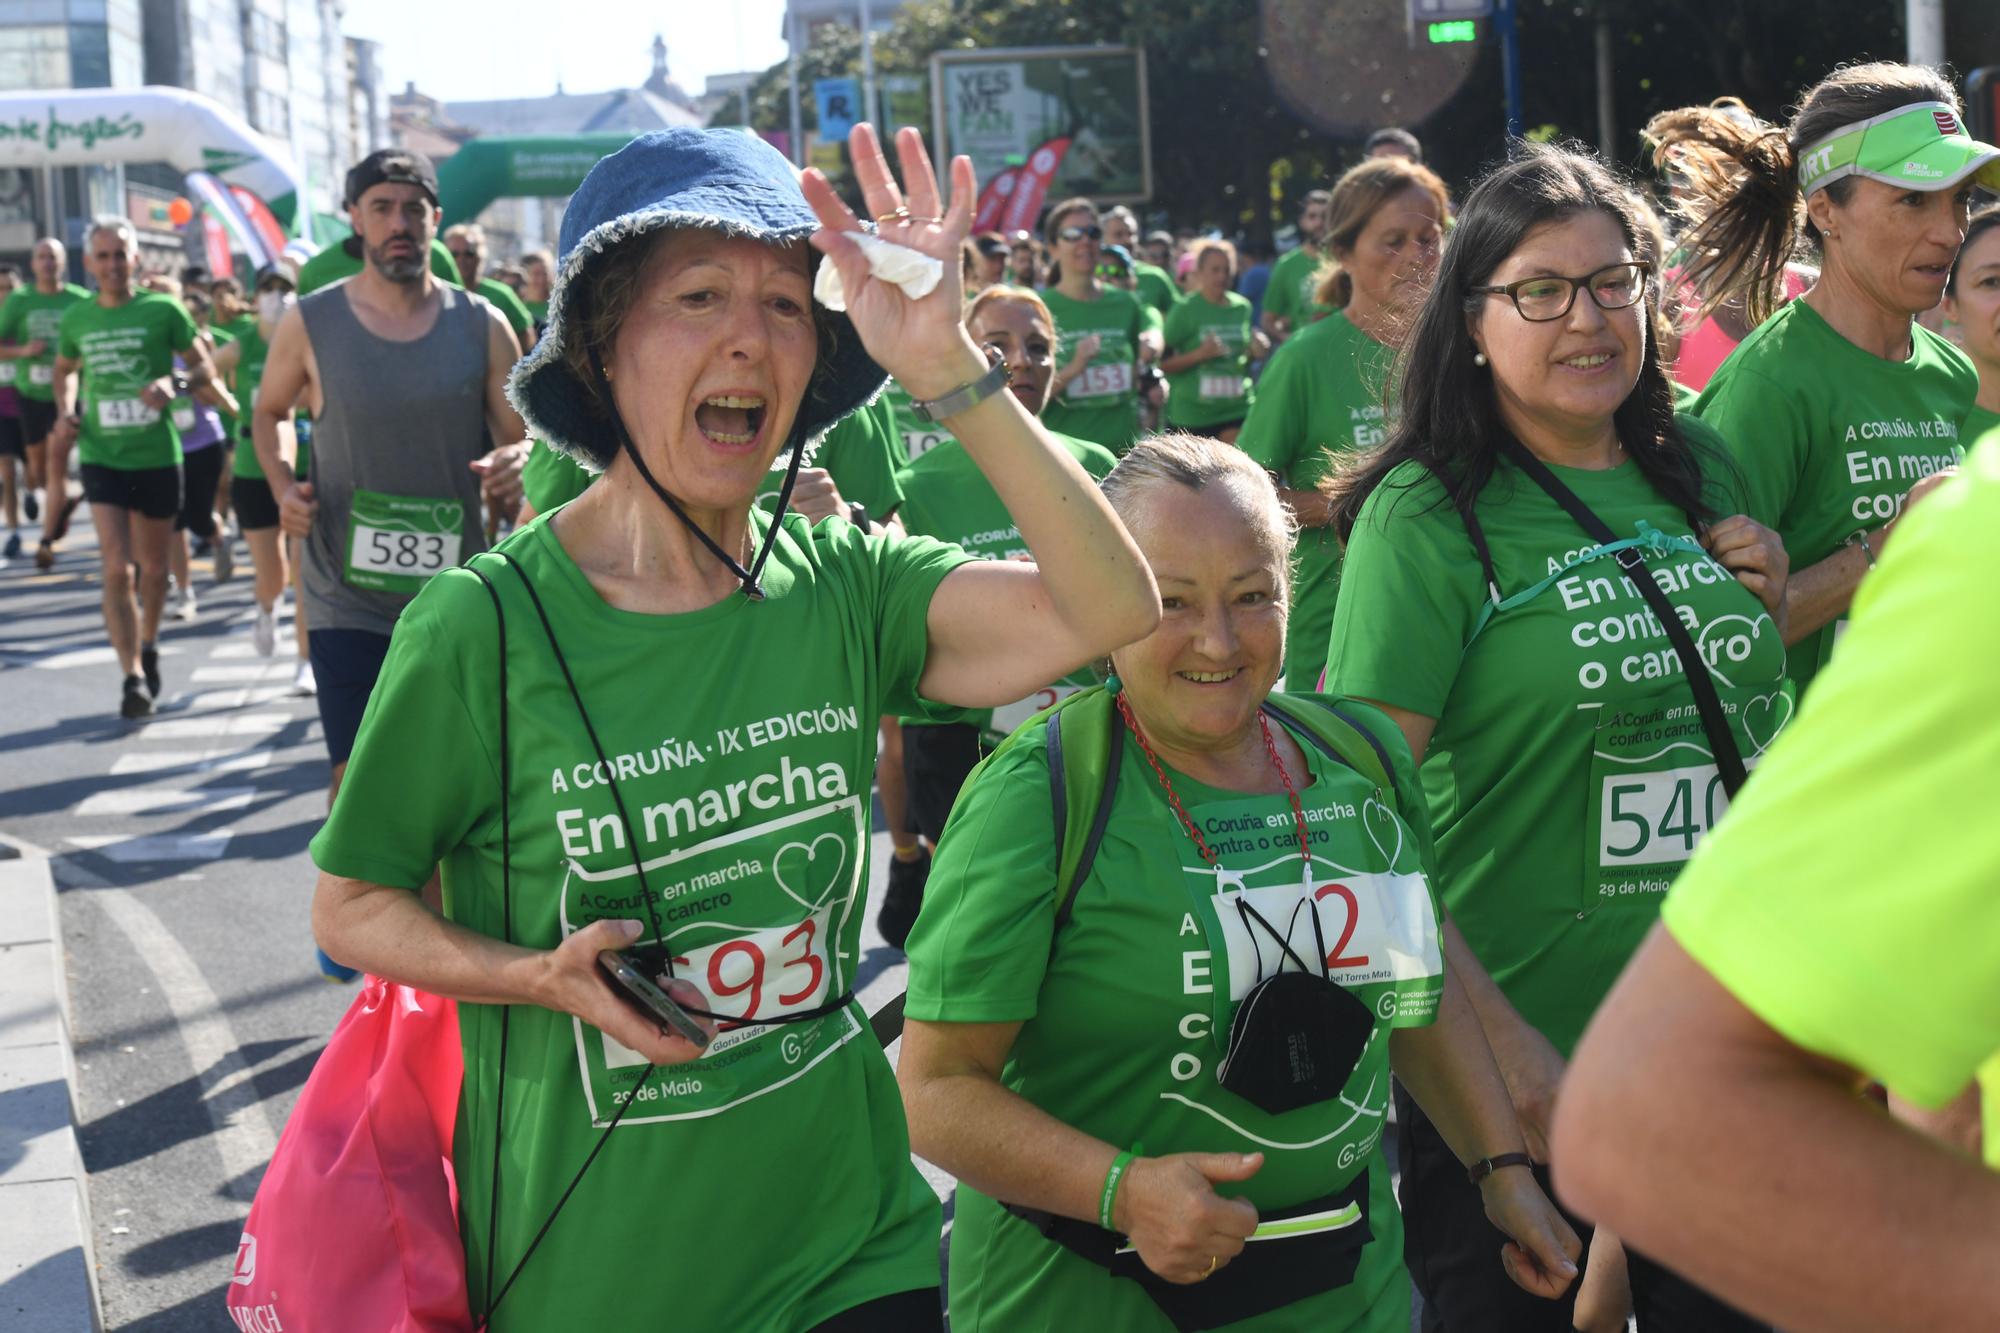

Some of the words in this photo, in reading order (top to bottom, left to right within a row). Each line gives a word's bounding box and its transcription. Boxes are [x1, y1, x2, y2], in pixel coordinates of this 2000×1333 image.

[957, 70, 1011, 95] YES
[1079, 365, 1126, 394] 153
[1353, 424, 1384, 446] En
[1845, 425, 1857, 442] A
[1861, 418, 1916, 440] CORUÑA
[1919, 421, 1934, 438] IX
[1846, 451, 1893, 484] En
[368, 532, 445, 570] 583
[961, 535, 972, 547] A
[1547, 556, 1563, 576] A
[1557, 575, 1617, 611] En
[1578, 662, 1607, 689] o
[1666, 707, 1681, 720] en
[551, 768, 568, 794] A
[572, 738, 705, 790] CORUÑA
[716, 727, 744, 756] IX
[747, 702, 859, 748] EDICIÓN
[1609, 732, 1652, 747] contra
[1655, 730, 1662, 740] o
[556, 808, 626, 858] En
[642, 756, 848, 843] marcha
[1206, 813, 1265, 834] Coruña
[1266, 813, 1289, 828] en
[1258, 837, 1270, 850] o
[580, 893, 592, 908] A
[663, 880, 687, 900] en
[690, 859, 764, 892] marcha
[1599, 883, 1616, 897] 29
[1619, 880, 1636, 894] de
[1639, 878, 1670, 894] Maio
[667, 891, 732, 922] cancro
[1179, 912, 1199, 937] A
[1346, 972, 1370, 982] Torres
[1372, 970, 1392, 979] Mata
[713, 1033, 740, 1052] Gloria
[742, 1025, 767, 1041] Ladra
[636, 1084, 658, 1102] de
[661, 1077, 703, 1099] Maio
